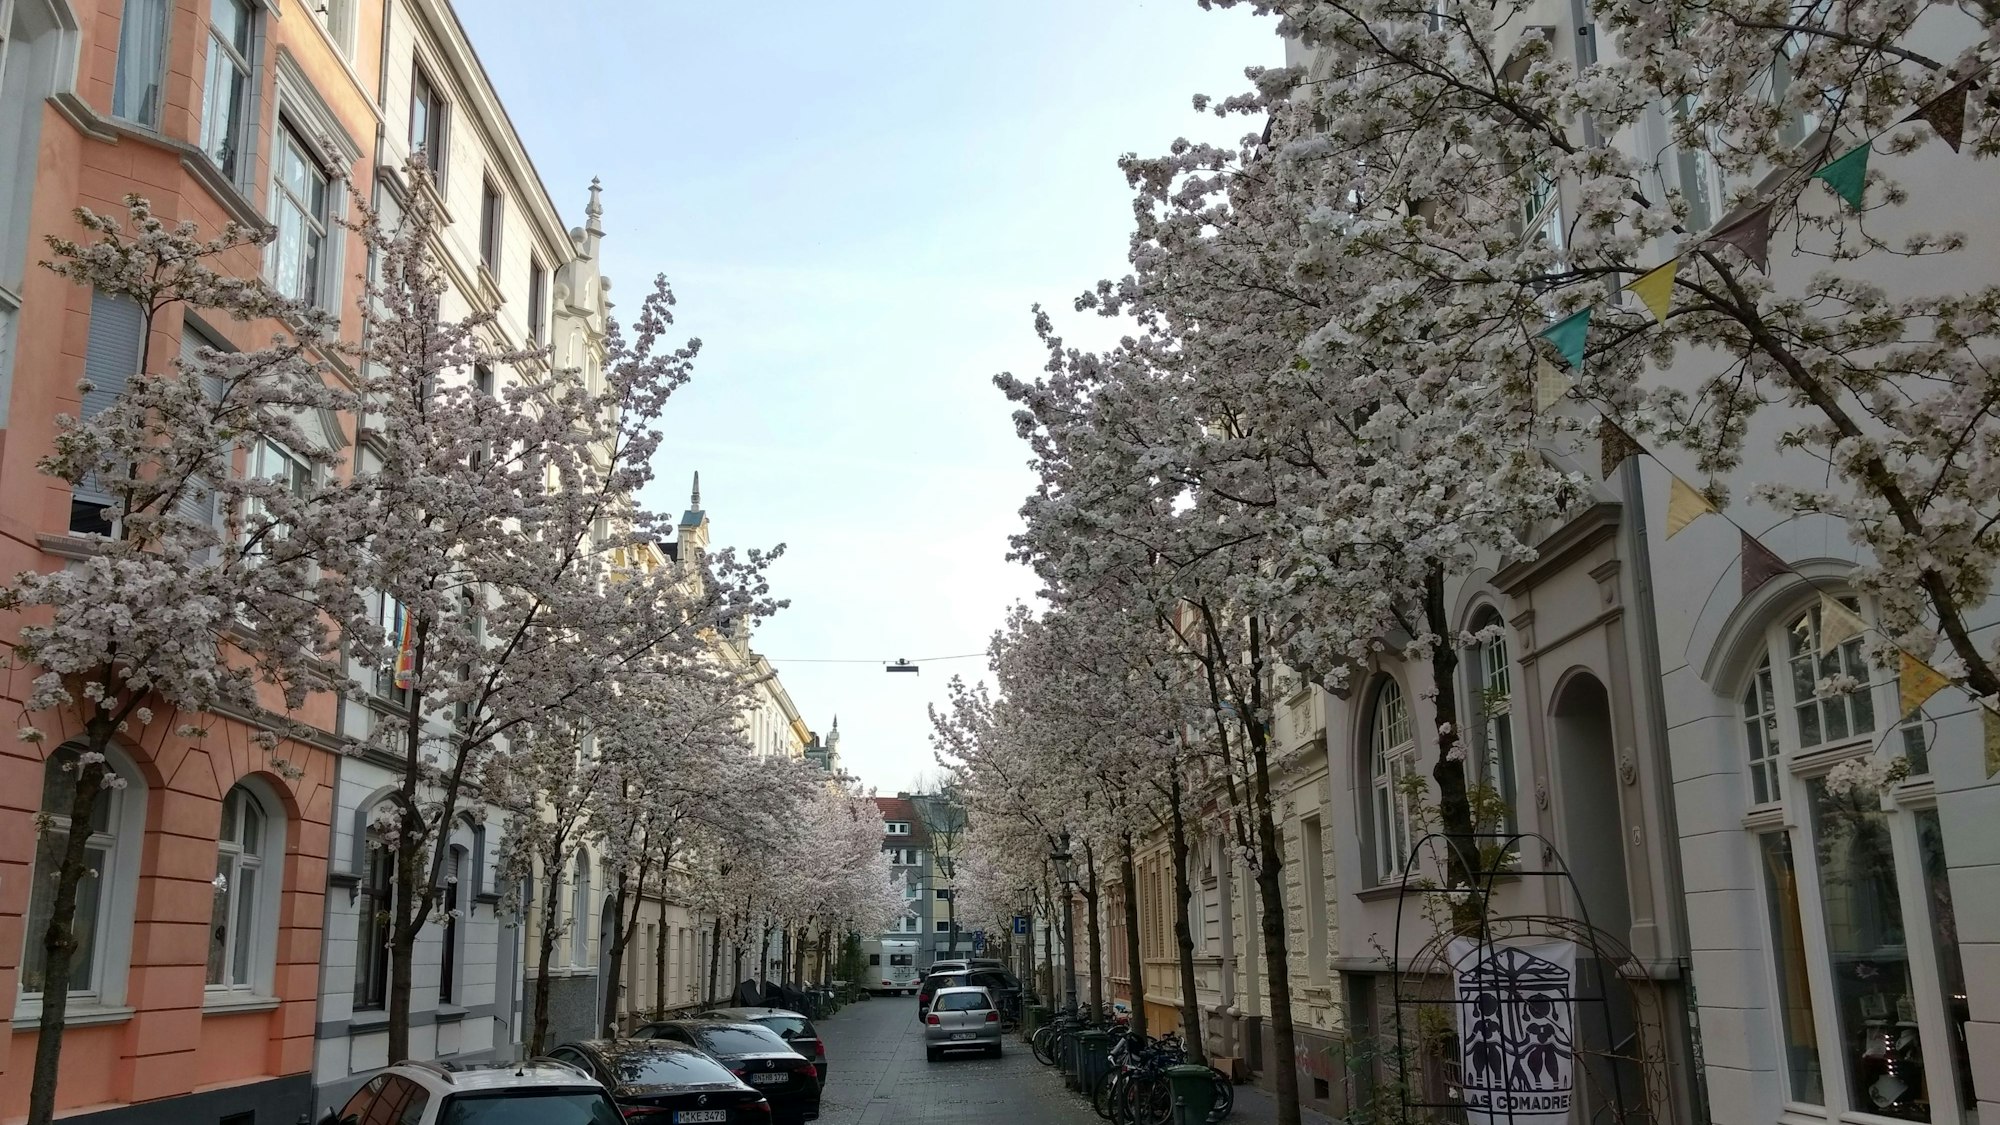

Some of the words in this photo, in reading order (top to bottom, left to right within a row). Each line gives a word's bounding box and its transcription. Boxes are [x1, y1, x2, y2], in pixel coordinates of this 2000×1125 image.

[1018, 918, 1026, 932] P
[1465, 1094, 1491, 1108] AS
[679, 1112, 686, 1122] M
[690, 1111, 702, 1122] KE
[704, 1110, 725, 1121] 3478
